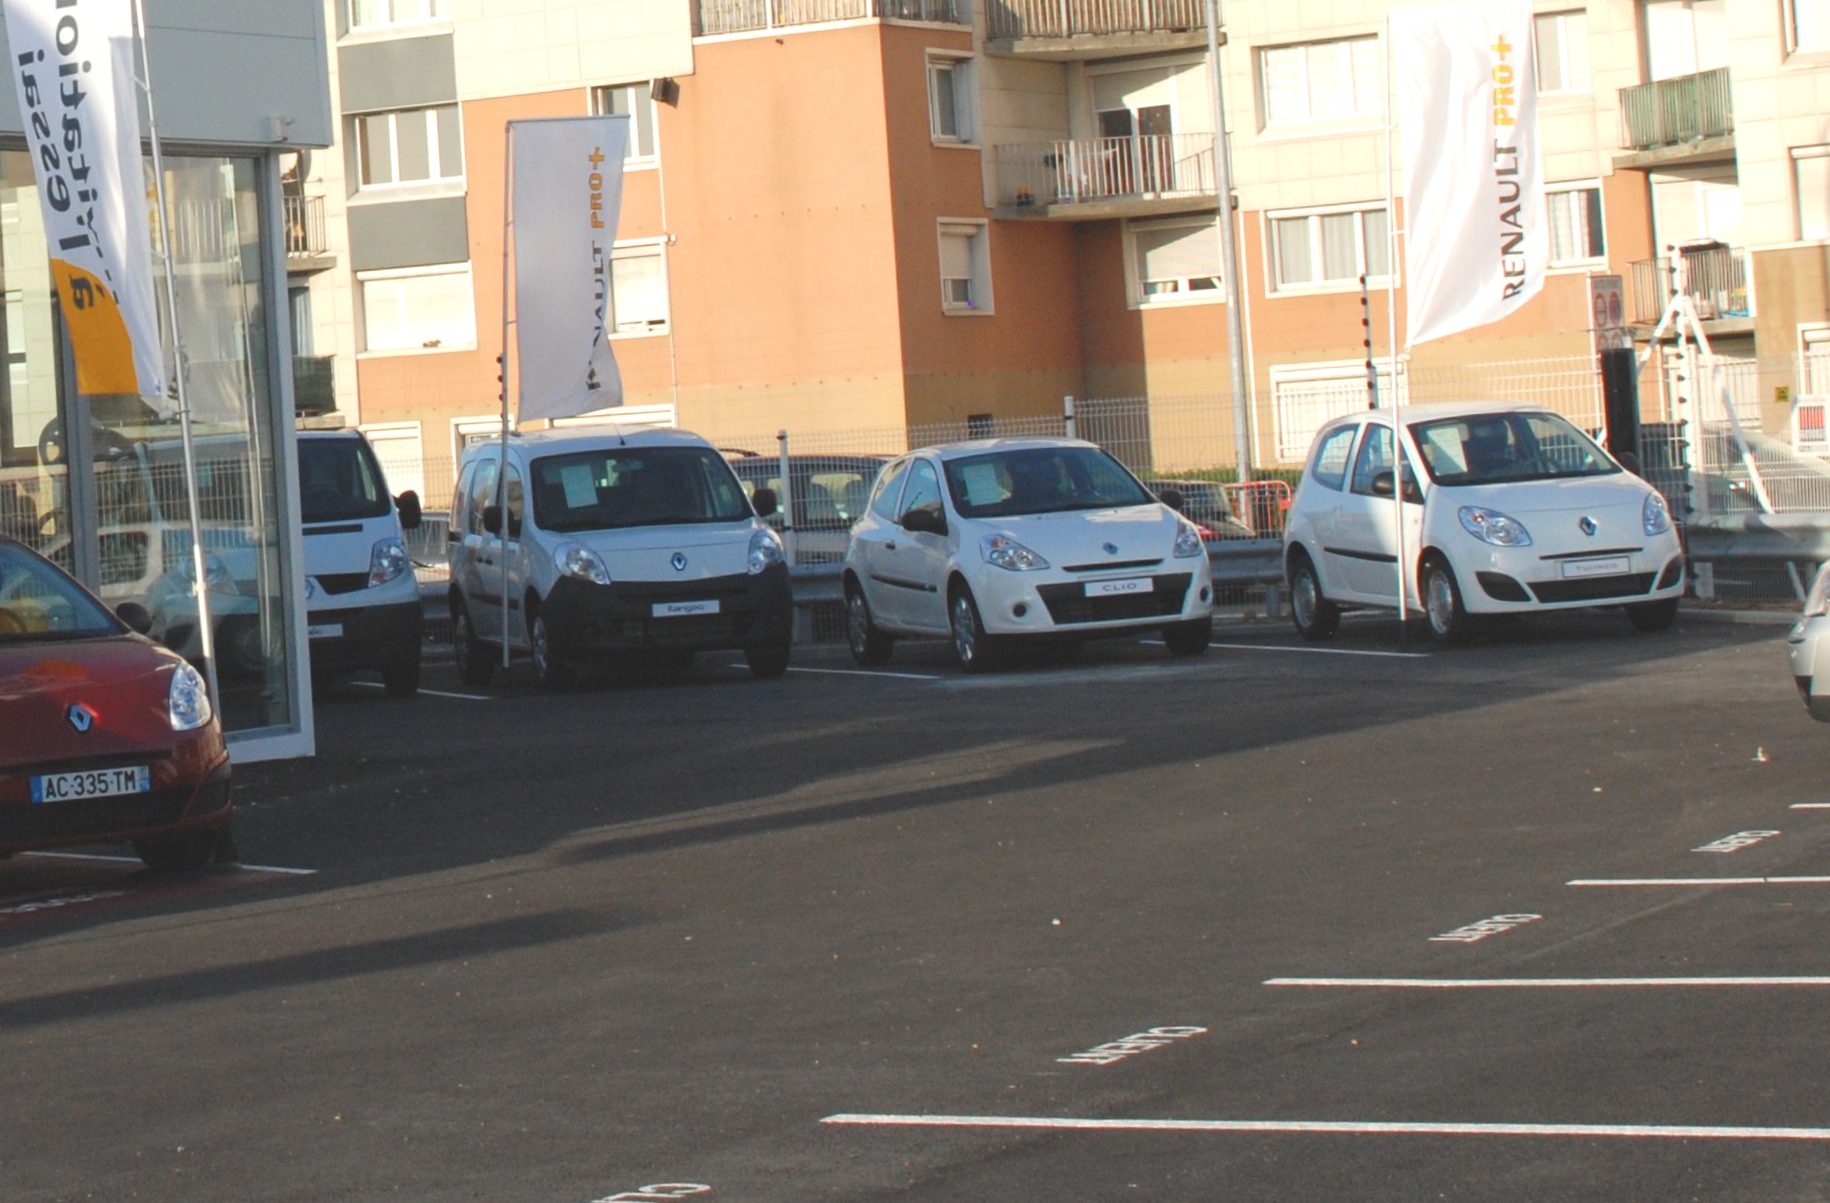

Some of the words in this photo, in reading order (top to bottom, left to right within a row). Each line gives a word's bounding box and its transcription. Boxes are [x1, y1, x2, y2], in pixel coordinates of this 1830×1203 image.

[1490, 34, 1517, 126] PRO+
[588, 146, 606, 229] PRO+
[1493, 139, 1526, 300] RENAULT
[668, 605, 705, 614] Kangoo
[1102, 582, 1137, 592] CLIO
[45, 770, 137, 799] AC-335-TM
